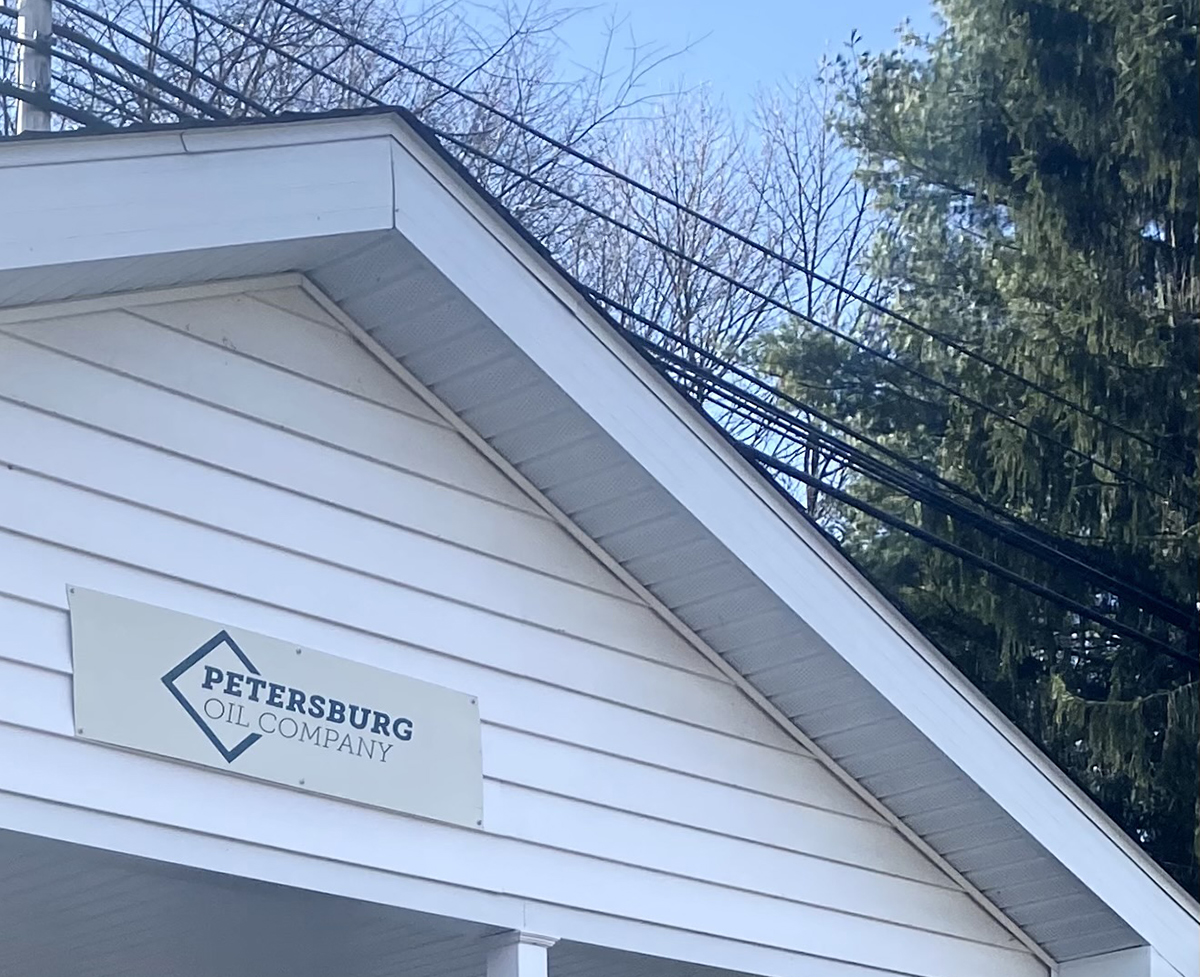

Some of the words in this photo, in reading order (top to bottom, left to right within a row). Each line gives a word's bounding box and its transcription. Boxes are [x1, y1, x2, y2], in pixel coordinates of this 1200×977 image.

[202, 664, 414, 742] PETERSBURG
[203, 698, 250, 728] OIL
[258, 712, 394, 763] COMPANY
